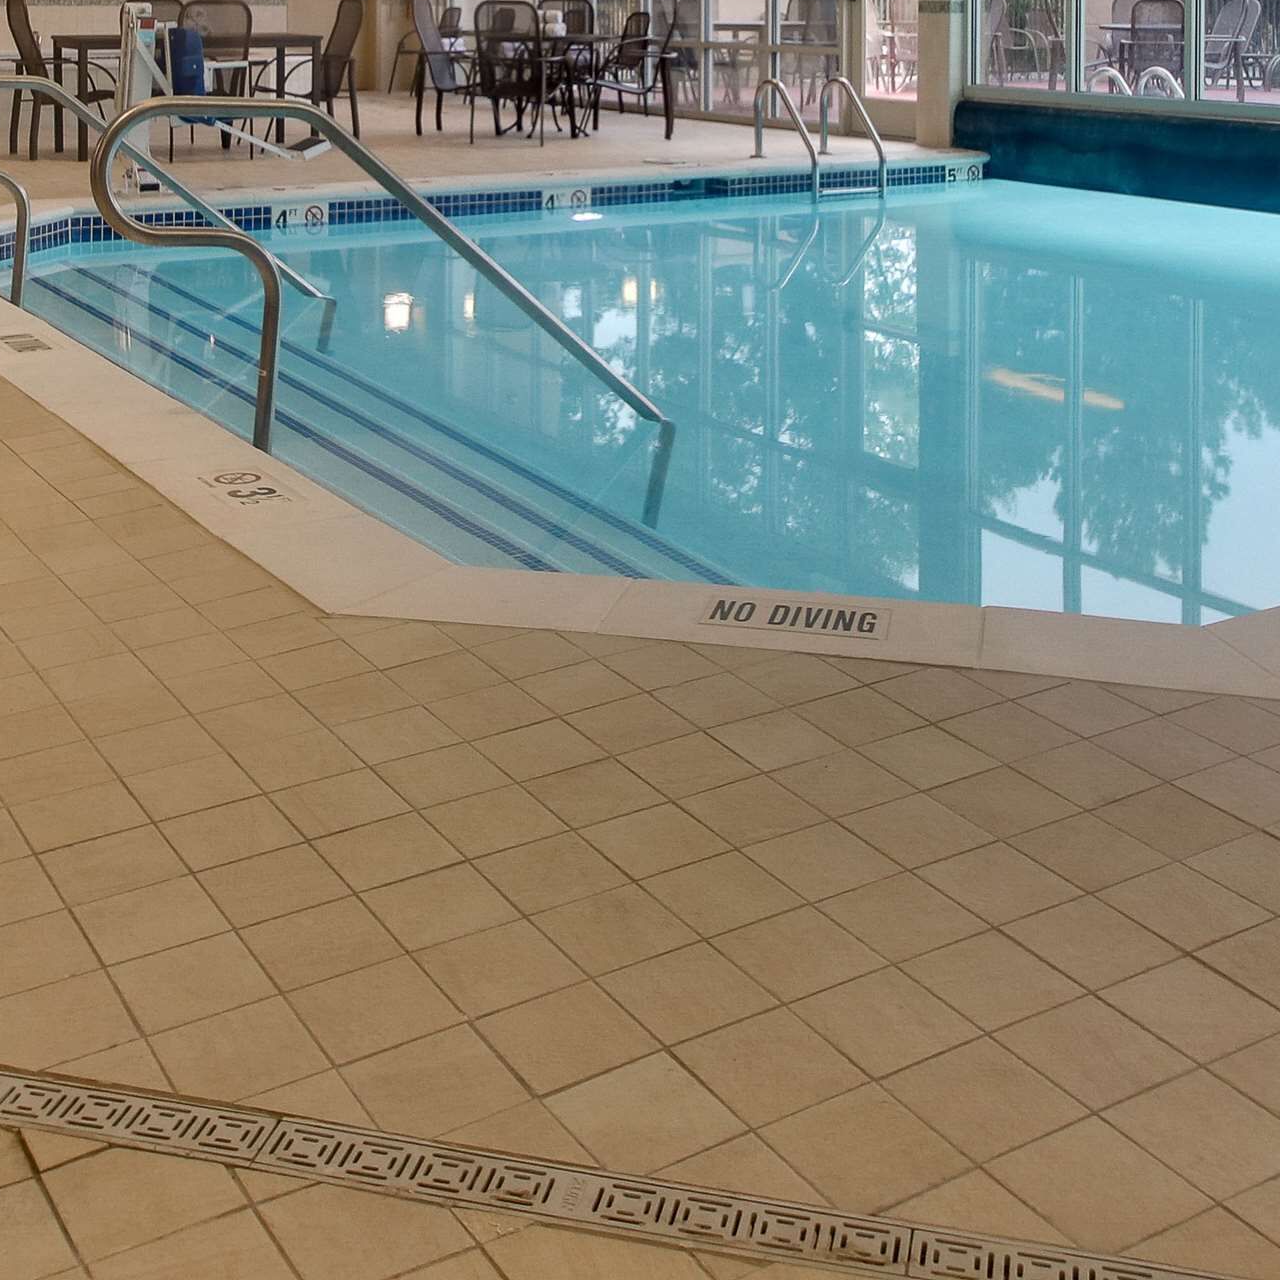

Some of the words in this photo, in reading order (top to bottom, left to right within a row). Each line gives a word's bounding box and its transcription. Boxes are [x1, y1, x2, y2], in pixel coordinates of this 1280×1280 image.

[948, 168, 957, 182] 5
[275, 209, 287, 227] 4
[709, 599, 757, 622] NO
[767, 604, 877, 633] DIVING
